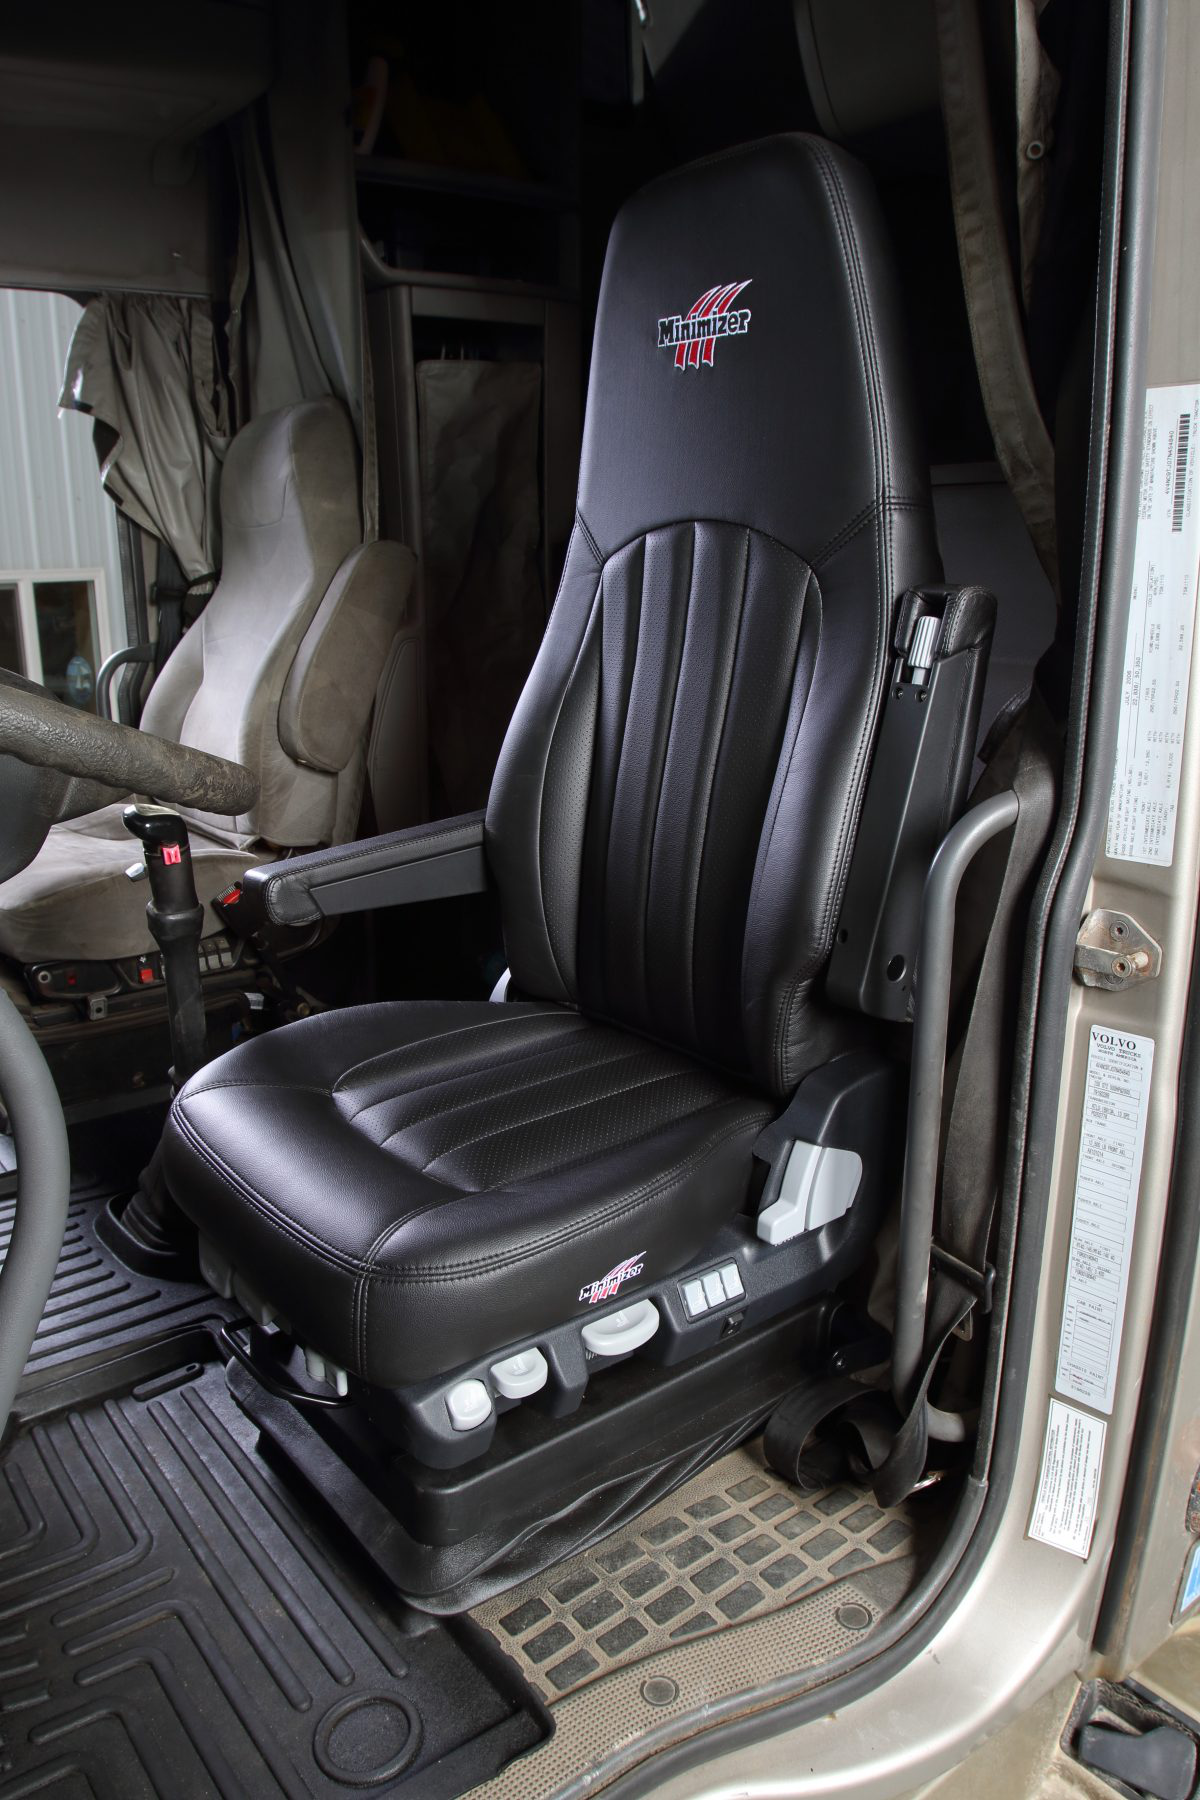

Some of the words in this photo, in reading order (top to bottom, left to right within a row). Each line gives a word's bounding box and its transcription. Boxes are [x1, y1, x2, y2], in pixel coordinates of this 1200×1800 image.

[658, 308, 752, 347] Minimizer
[1092, 1031, 1136, 1050] VOLVO
[1097, 1043, 1115, 1051] VOLVO
[1119, 1049, 1141, 1058] TRUCKS
[579, 1263, 644, 1301] Minimizer
